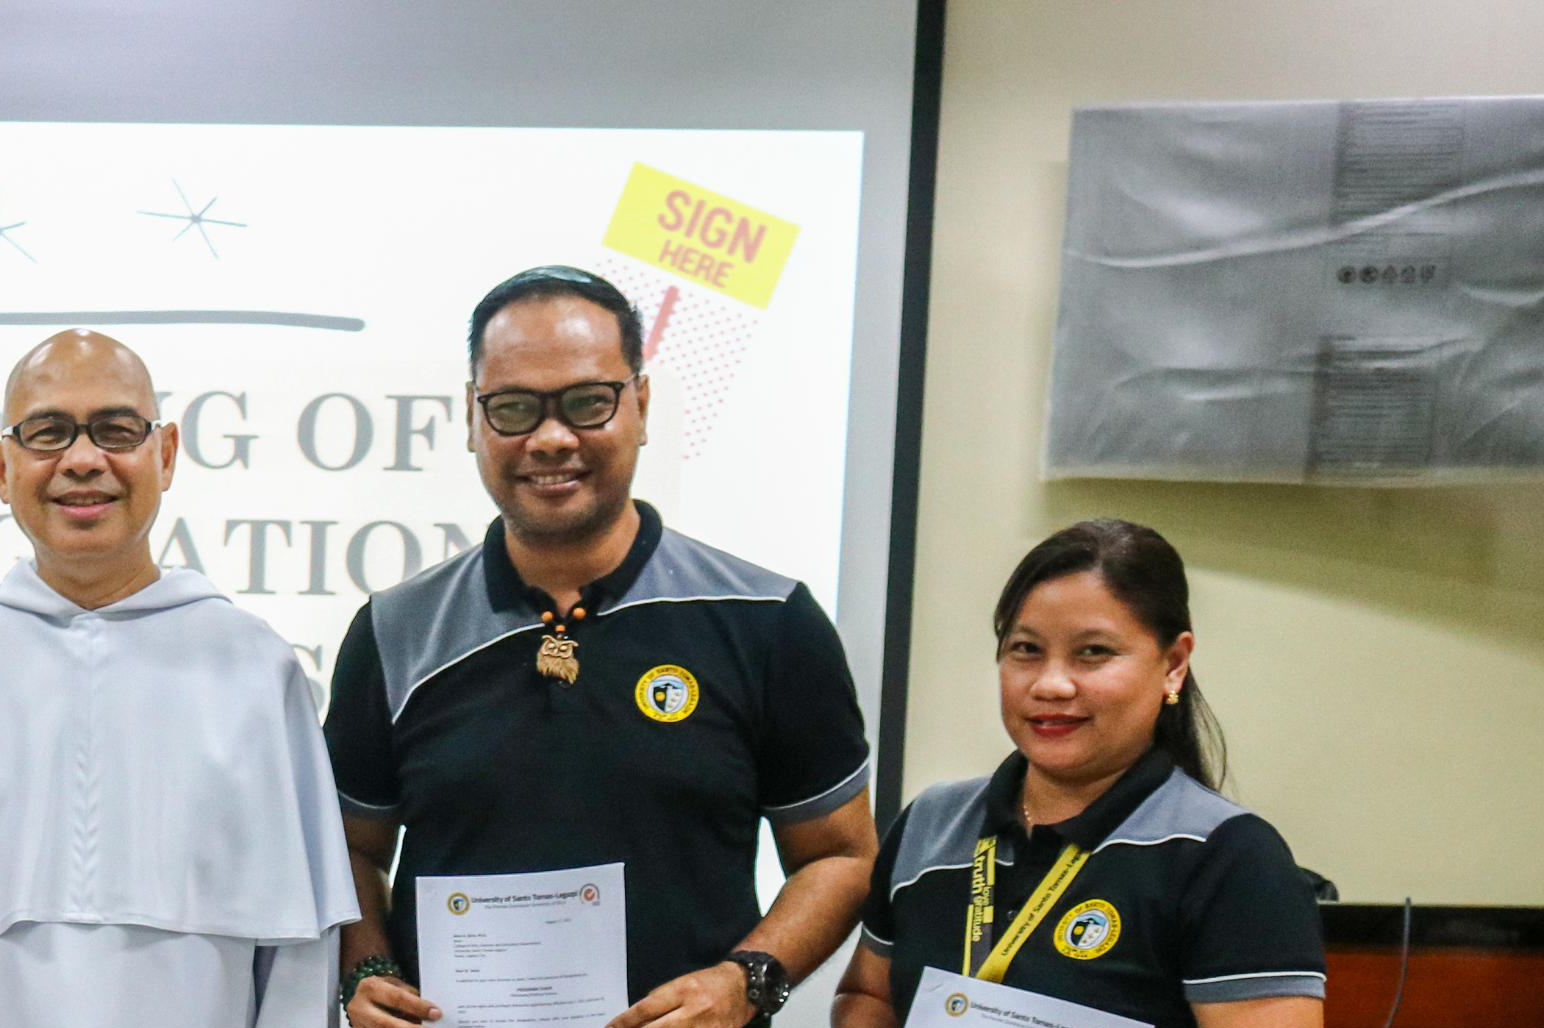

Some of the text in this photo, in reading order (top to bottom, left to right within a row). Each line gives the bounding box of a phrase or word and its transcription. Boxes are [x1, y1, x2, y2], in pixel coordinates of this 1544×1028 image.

[657, 189, 768, 264] SIGN
[658, 239, 735, 289] HERE
[296, 392, 454, 472] OF
[971, 855, 987, 895] truth
